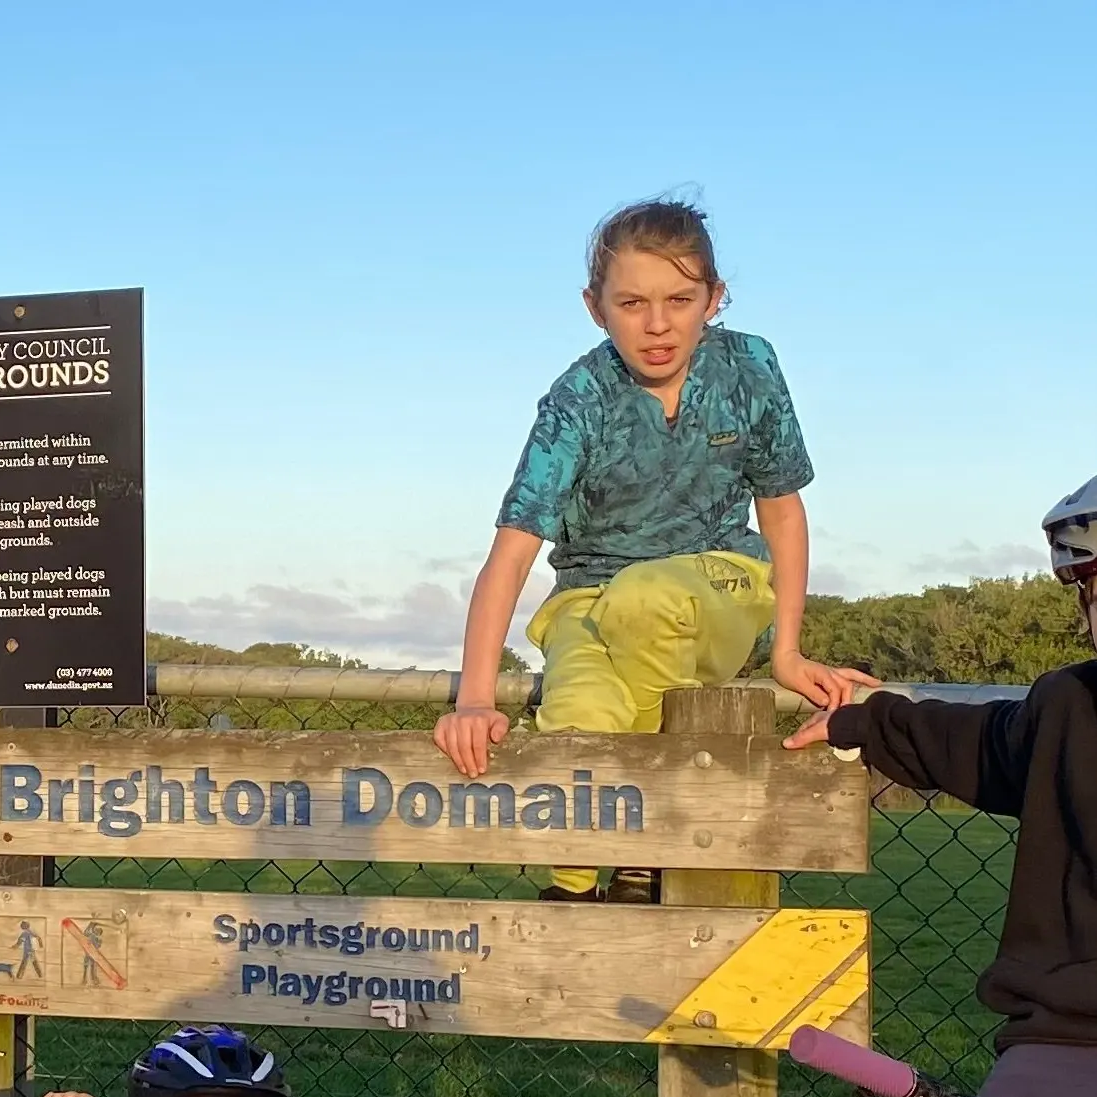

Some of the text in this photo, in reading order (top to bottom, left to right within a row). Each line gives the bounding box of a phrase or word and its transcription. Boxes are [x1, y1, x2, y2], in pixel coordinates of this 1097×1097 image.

[13, 337, 111, 360] COUNCIL
[50, 433, 91, 448] within
[37, 455, 50, 466] at
[51, 455, 75, 468] any
[77, 452, 109, 465] time.
[22, 495, 64, 514] played
[65, 495, 97, 512] dogs
[27, 513, 51, 529] and
[53, 512, 100, 528] outside
[0, 532, 53, 550] grounds.
[31, 566, 73, 585] played
[74, 566, 105, 583] dogs
[8, 585, 30, 600] but
[32, 587, 64, 599] must
[66, 585, 111, 599] remain
[47, 603, 102, 620] grounds.
[56, 667, 113, 679] (03) 477 4000
[24, 680, 113, 691] www.dunedin.govt.nz
[0, 763, 645, 838] Brighton Domain
[212, 914, 491, 961] Sportsground,
[241, 964, 461, 1006] Playground
